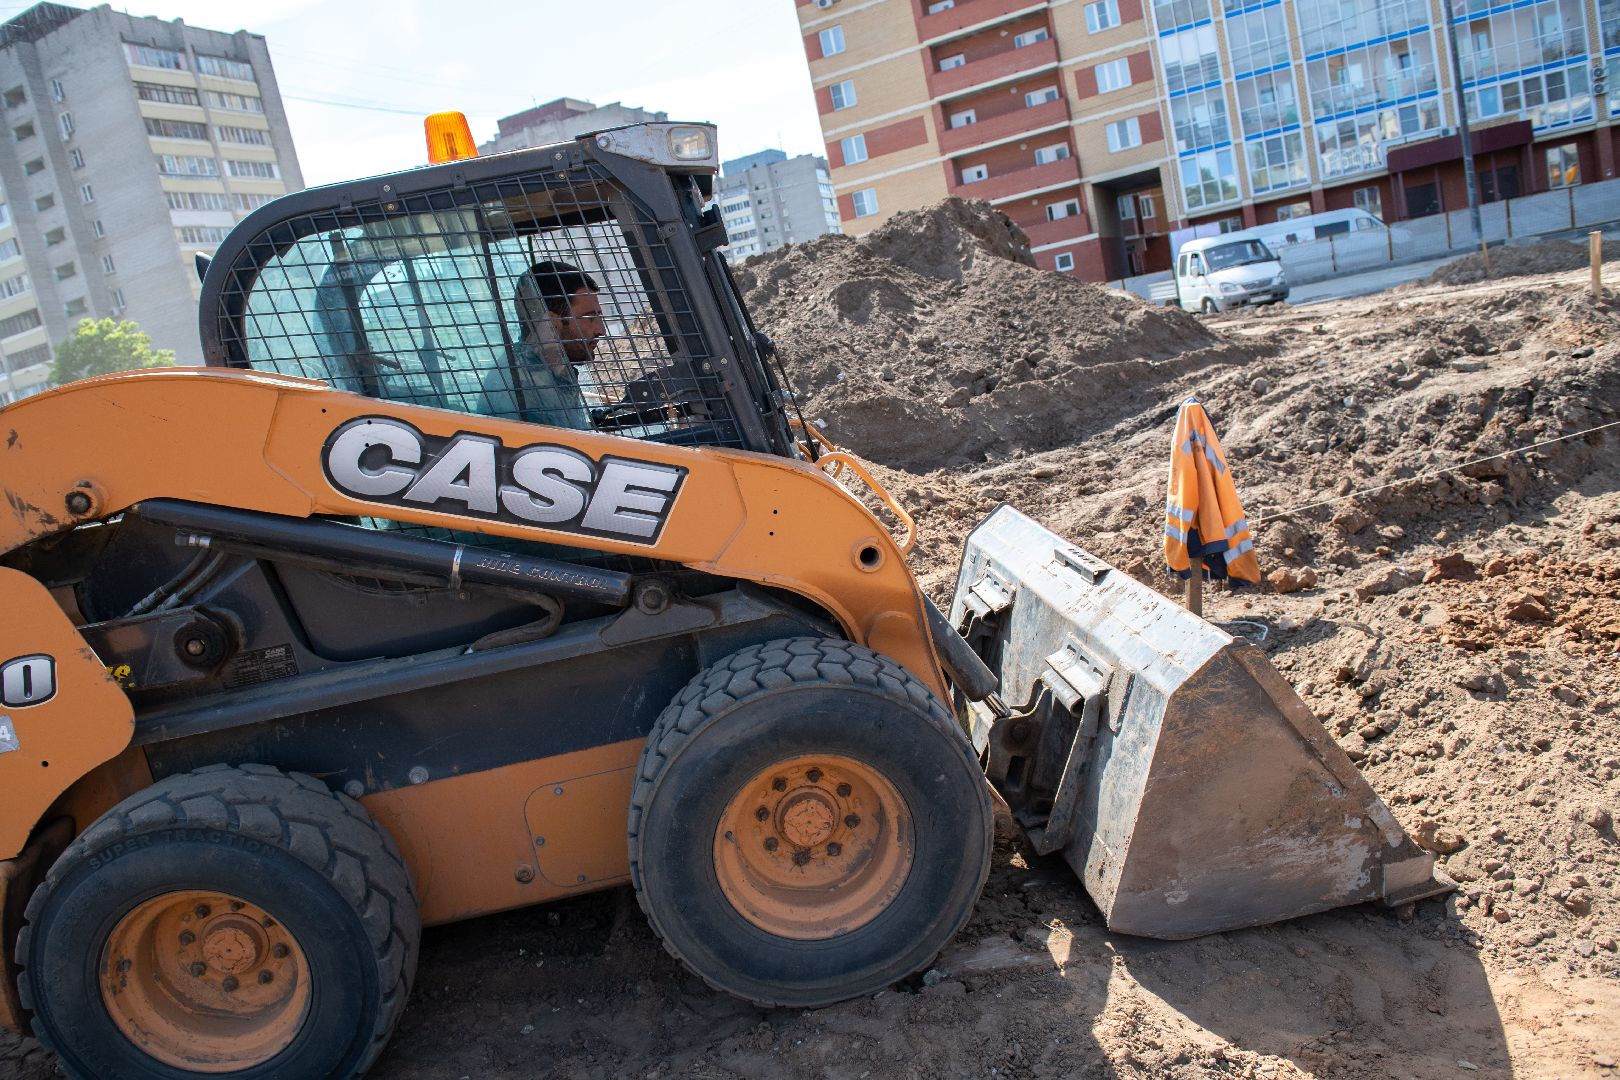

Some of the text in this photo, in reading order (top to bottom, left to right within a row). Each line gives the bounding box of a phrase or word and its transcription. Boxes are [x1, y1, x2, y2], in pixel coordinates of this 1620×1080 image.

[325, 419, 684, 542] CASE
[88, 828, 279, 870] SUPER TRACTION
